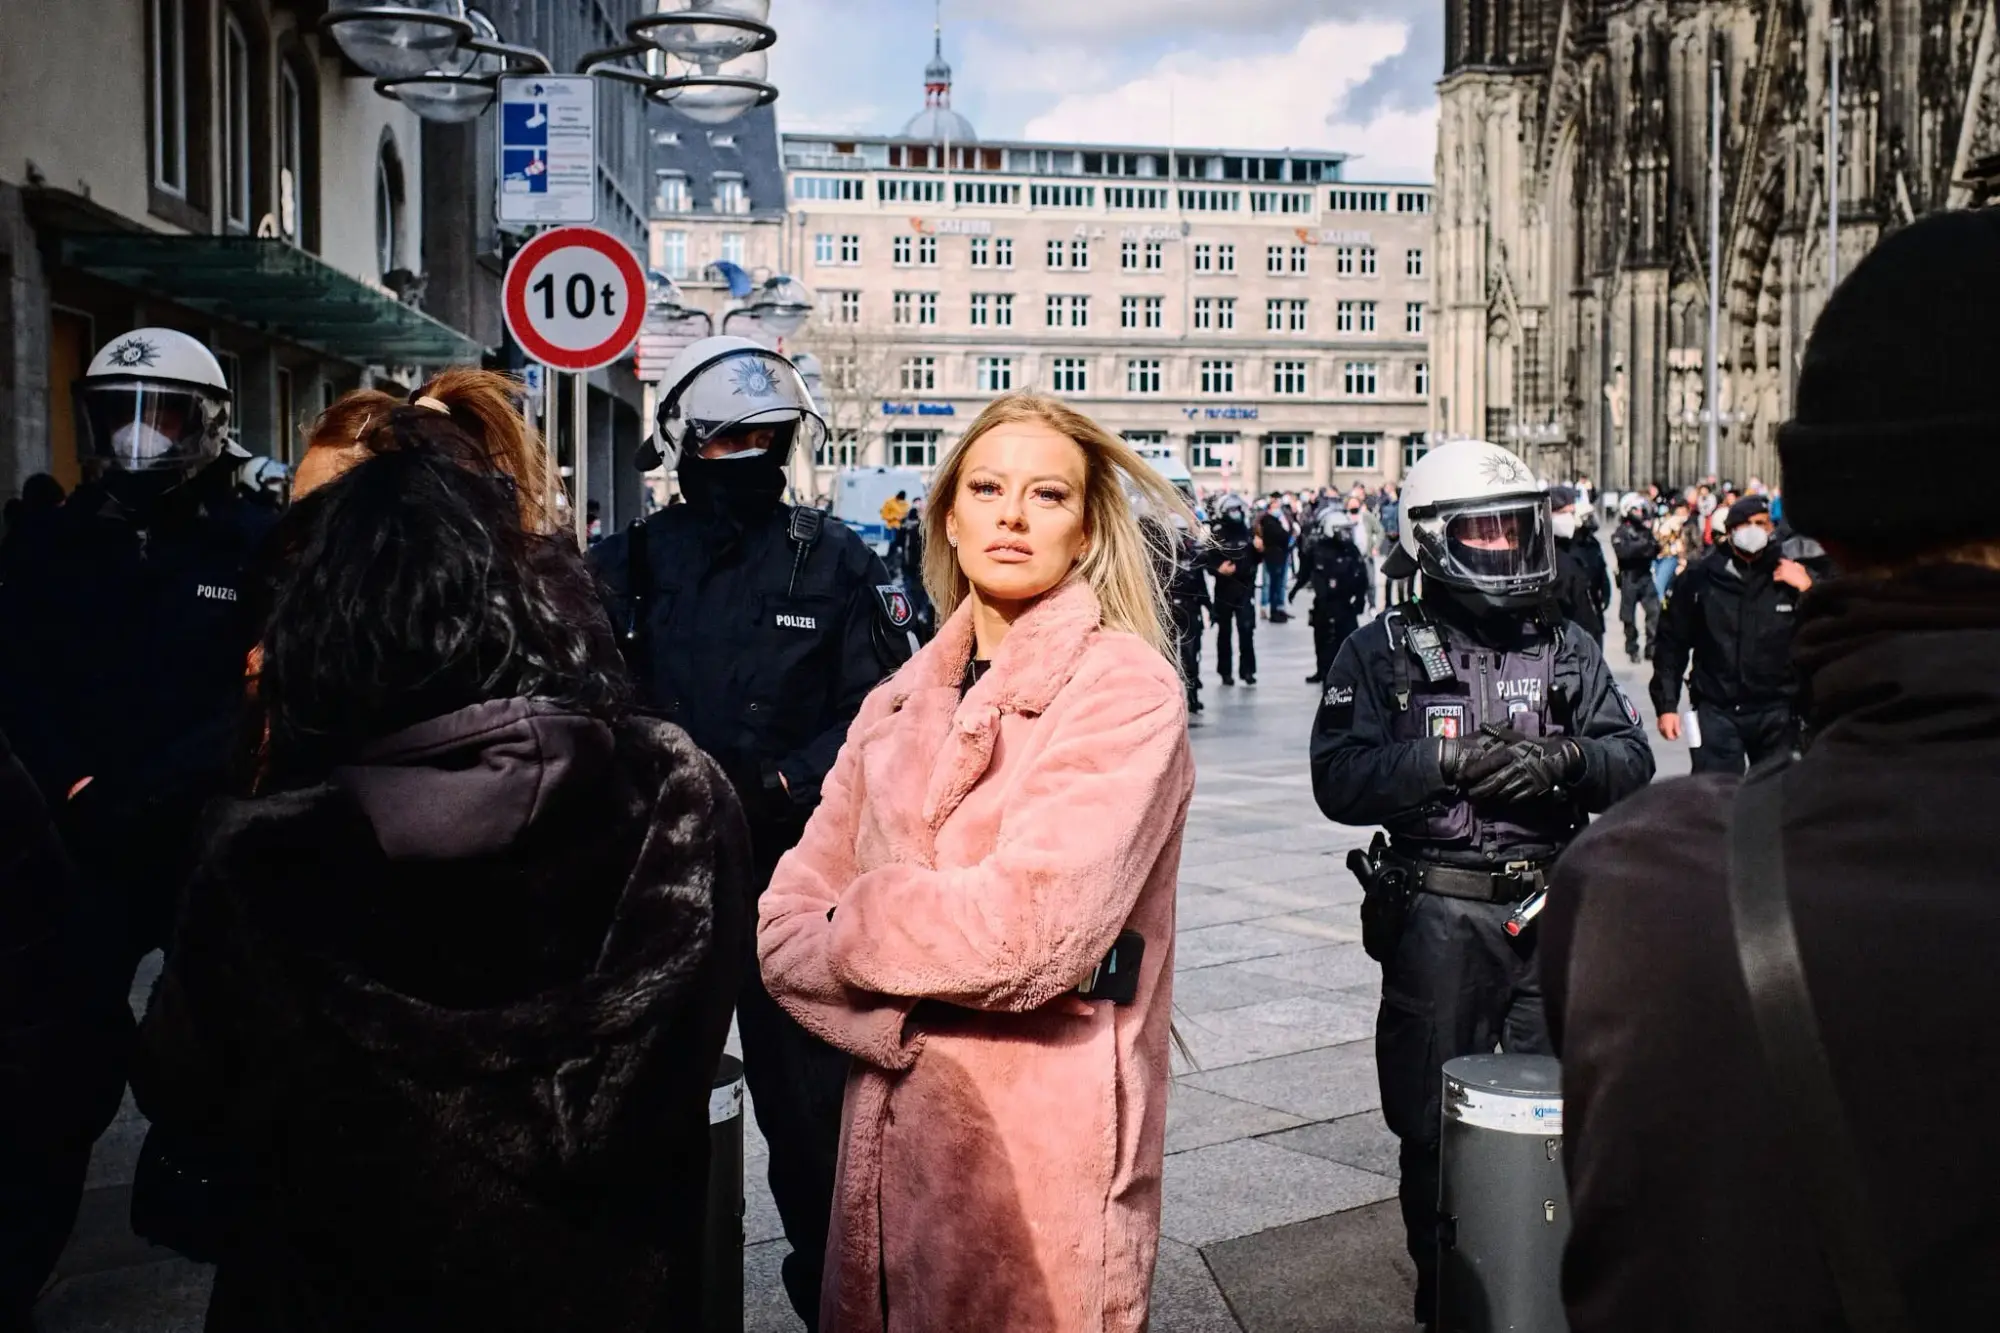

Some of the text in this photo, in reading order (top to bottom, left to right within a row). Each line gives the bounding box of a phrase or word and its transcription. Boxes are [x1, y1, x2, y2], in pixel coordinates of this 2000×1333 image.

[533, 272, 616, 319] 10t
[776, 614, 816, 629] POLIZEI
[1429, 706, 1460, 717] POLIZEI
